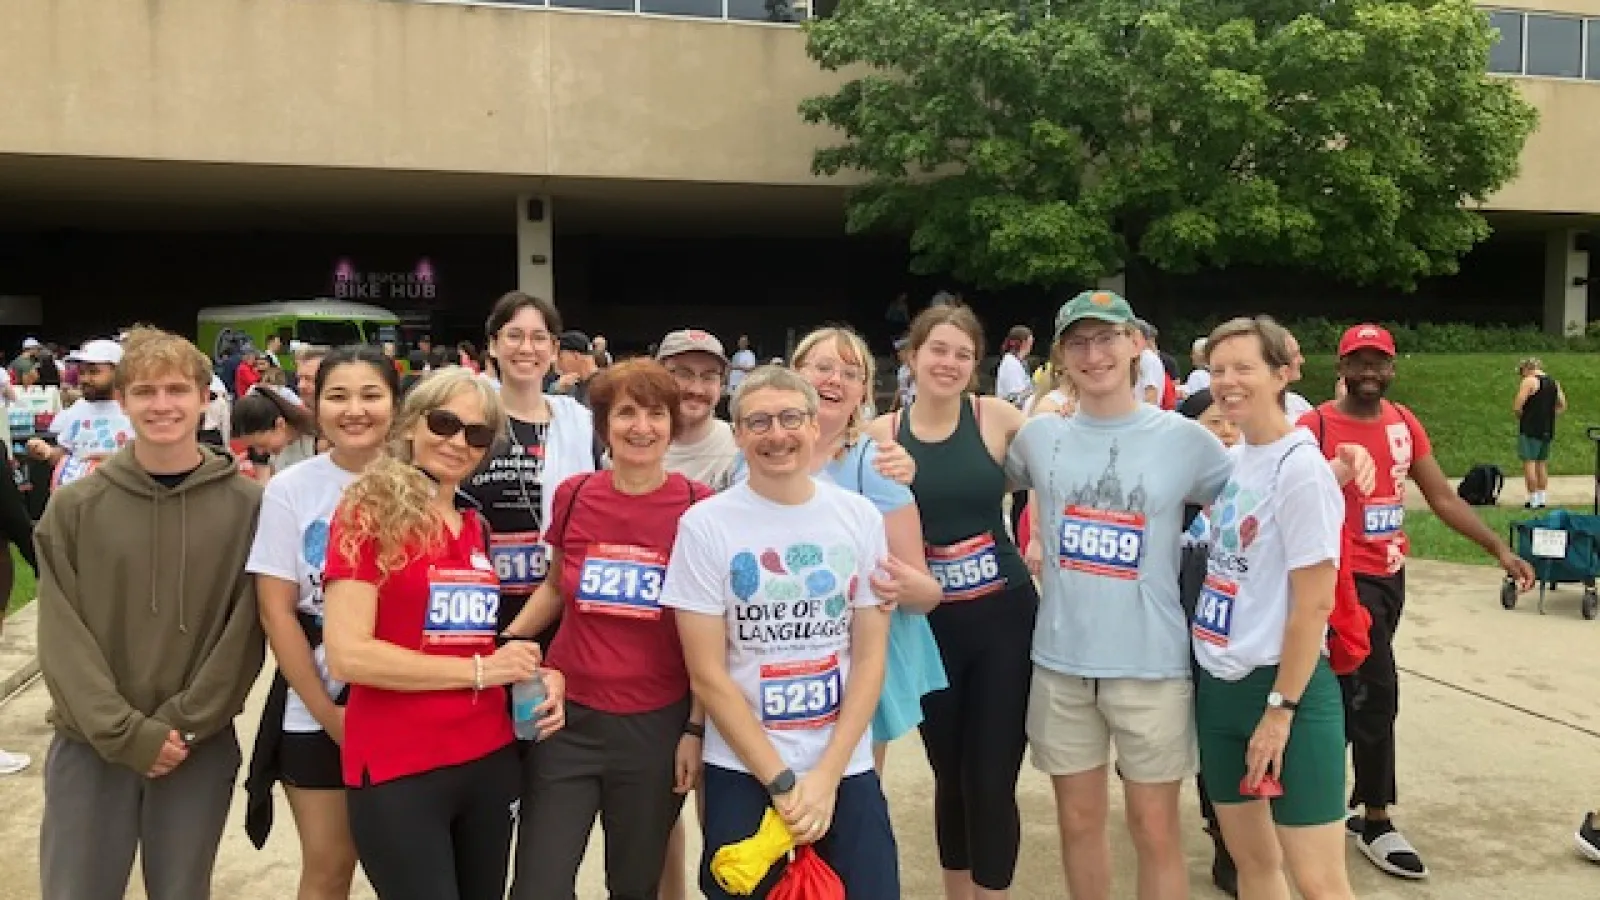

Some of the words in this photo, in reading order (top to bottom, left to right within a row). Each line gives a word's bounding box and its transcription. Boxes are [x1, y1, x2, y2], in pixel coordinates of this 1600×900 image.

[334, 284, 381, 298] BIKE
[390, 284, 436, 298] HUB
[1064, 523, 1139, 562] 5659
[581, 564, 661, 601] 5213
[929, 553, 998, 589] 5556
[430, 590, 499, 625] 5062
[792, 599, 821, 618] OF
[763, 675, 839, 716] 5231
